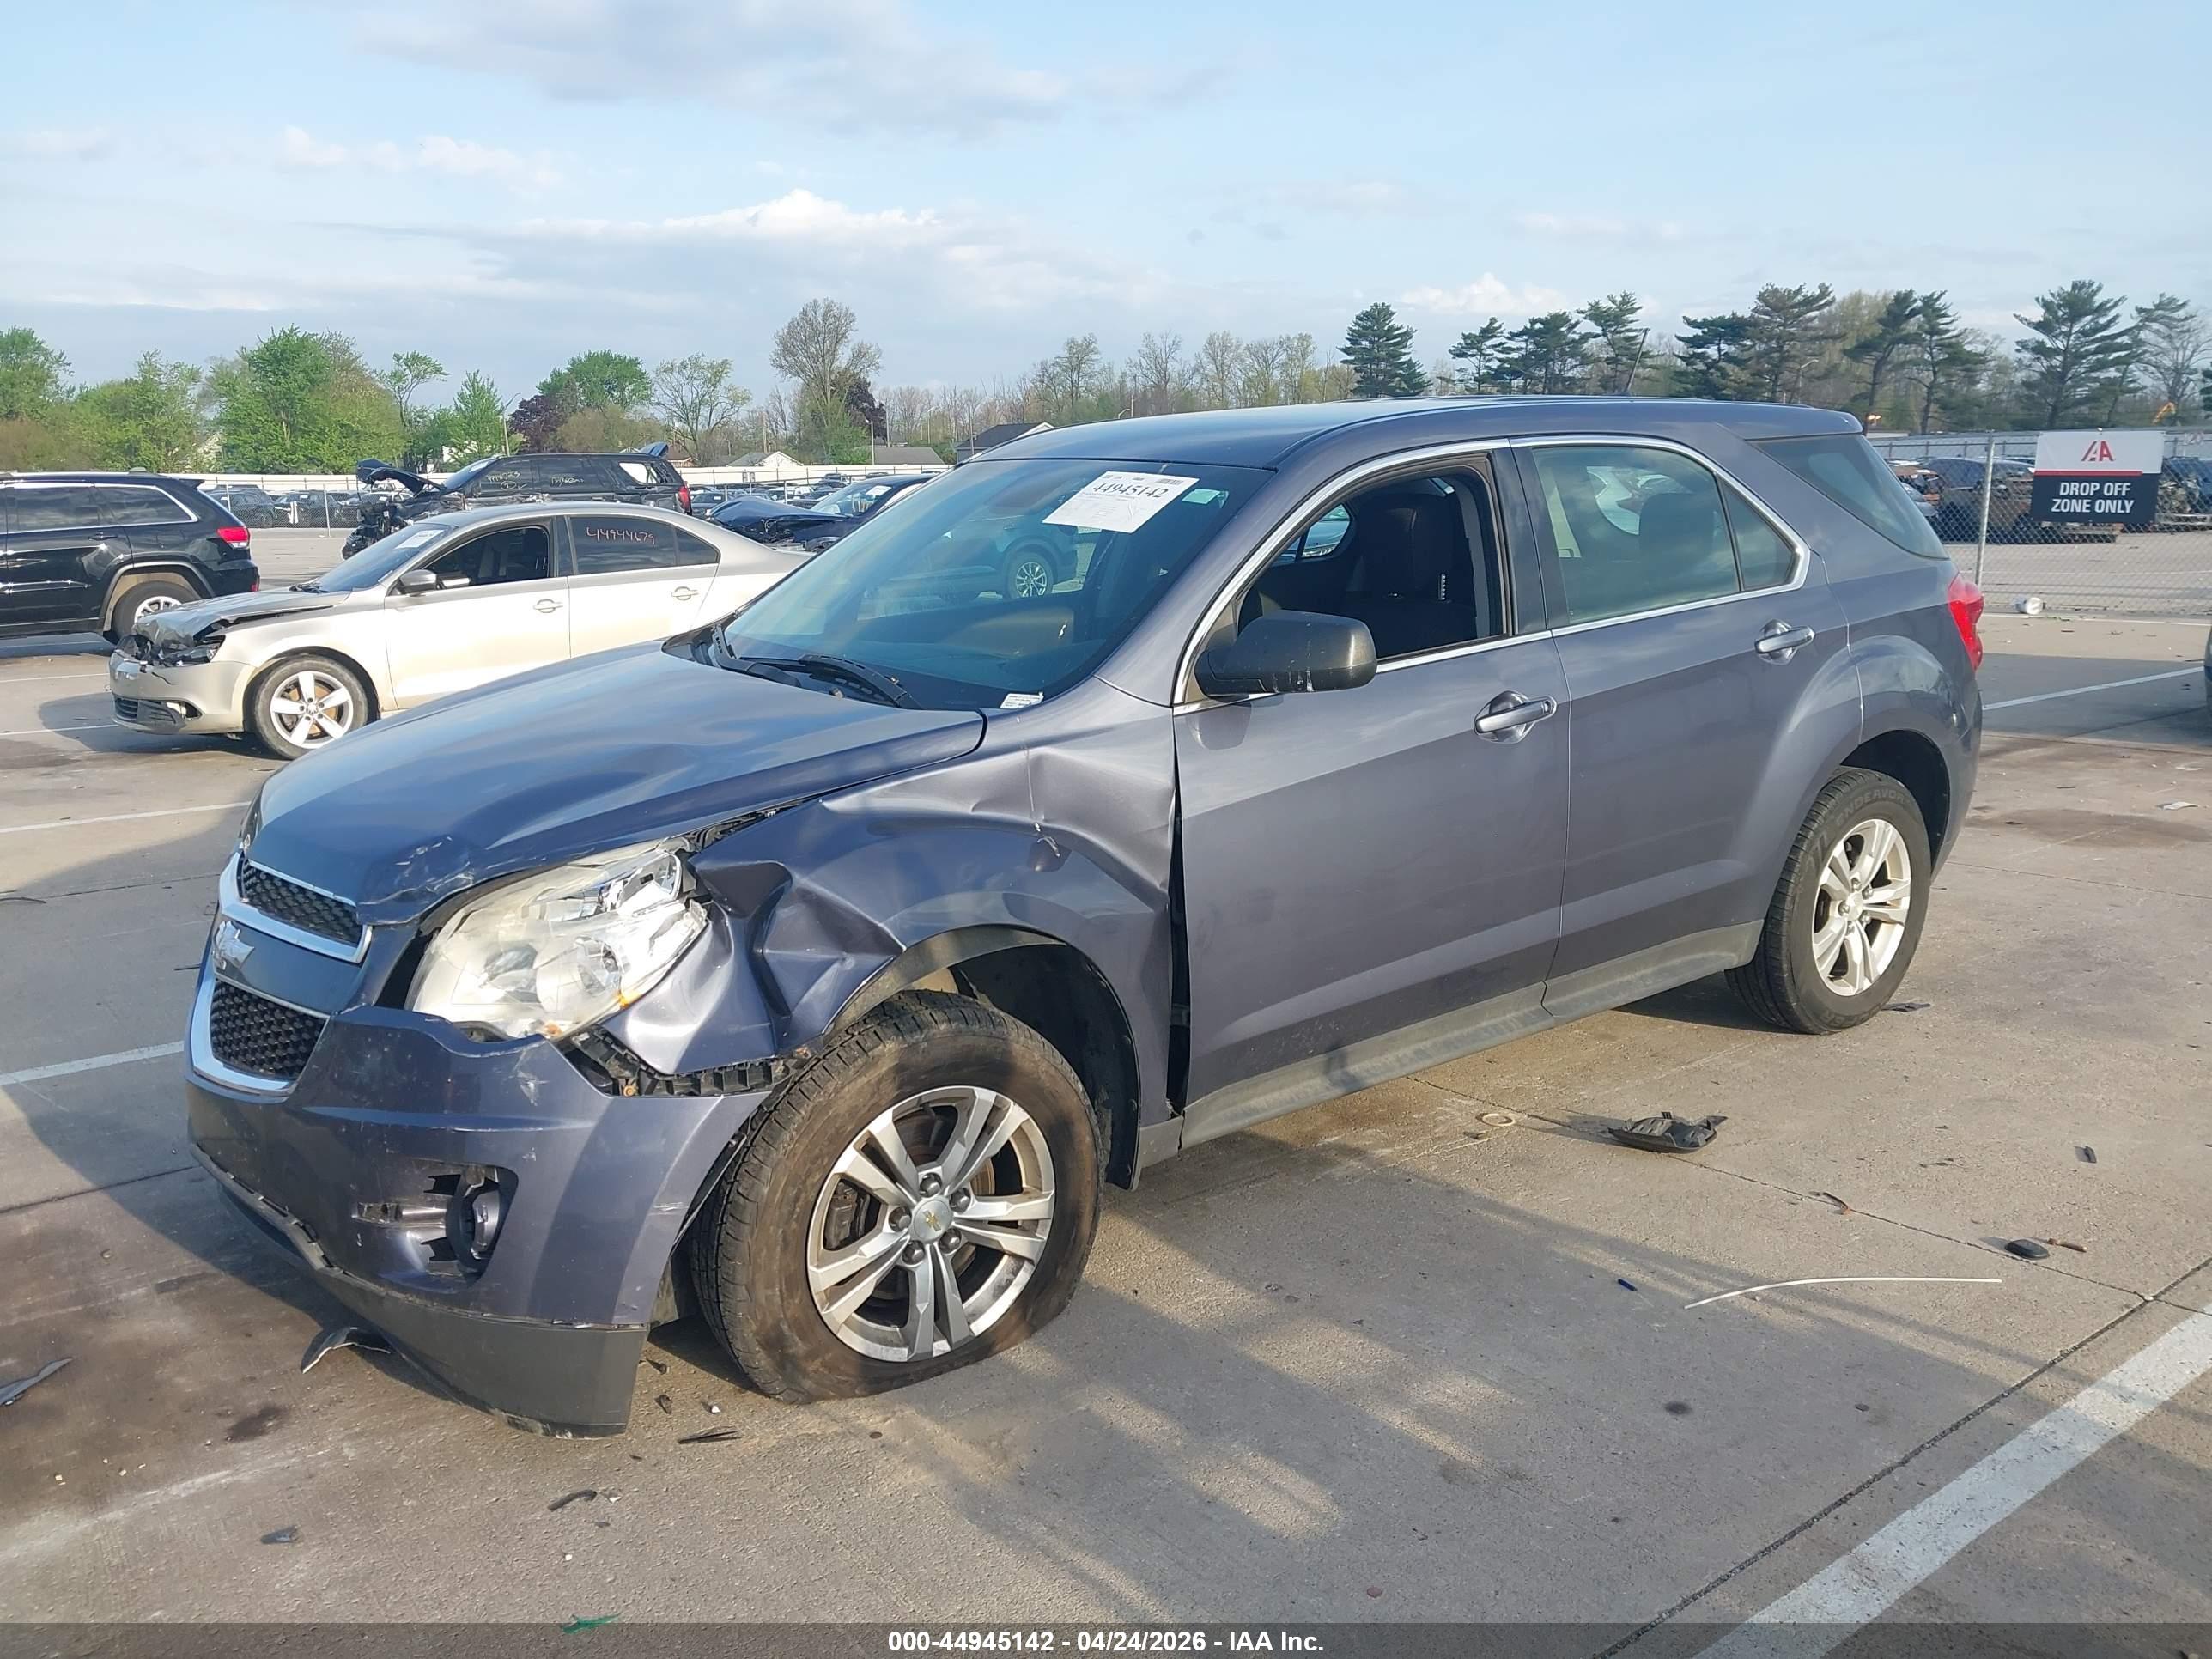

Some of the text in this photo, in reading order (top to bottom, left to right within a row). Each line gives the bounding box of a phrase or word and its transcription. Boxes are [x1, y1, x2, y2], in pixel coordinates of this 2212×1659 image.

[1092, 483, 1169, 498] 44945142
[2059, 482, 2131, 496] DROP OFF
[2051, 499, 2135, 514] ZONE ONLY
[586, 526, 655, 544] 44944679
